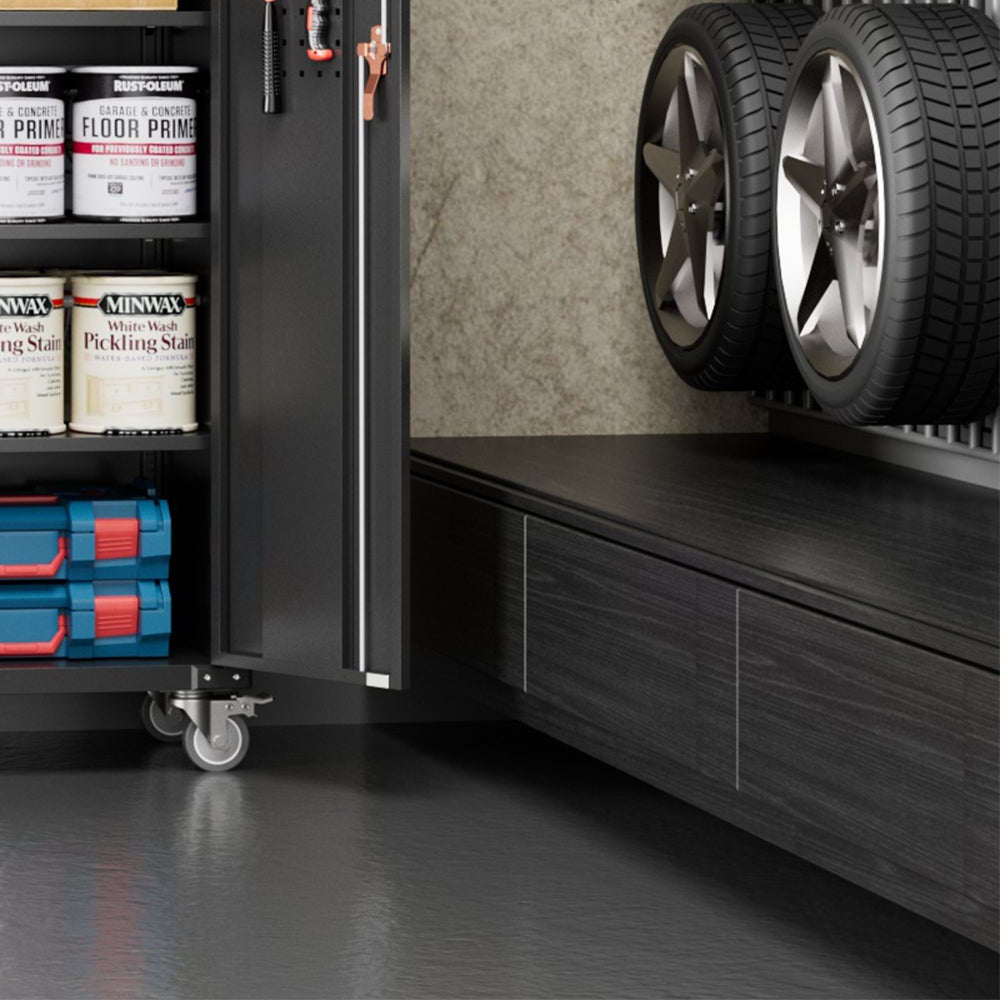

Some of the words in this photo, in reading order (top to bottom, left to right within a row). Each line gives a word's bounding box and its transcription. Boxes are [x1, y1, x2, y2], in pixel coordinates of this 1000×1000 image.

[114, 80, 183, 92] RUST-OLEUM
[7, 107, 14, 116] &
[18, 105, 57, 116] CONCRETE
[100, 105, 137, 116] GARAGE
[142, 106, 148, 116] &
[152, 105, 191, 116] CONCRETE
[82, 117, 139, 138] FLOOR
[107, 296, 181, 313] MINWAX
[13, 322, 44, 333] Wash
[108, 320, 146, 332] White
[148, 320, 177, 332] Wash
[27, 335, 61, 352] Stain
[84, 332, 157, 354] Pickling
[161, 333, 194, 350] Stain
